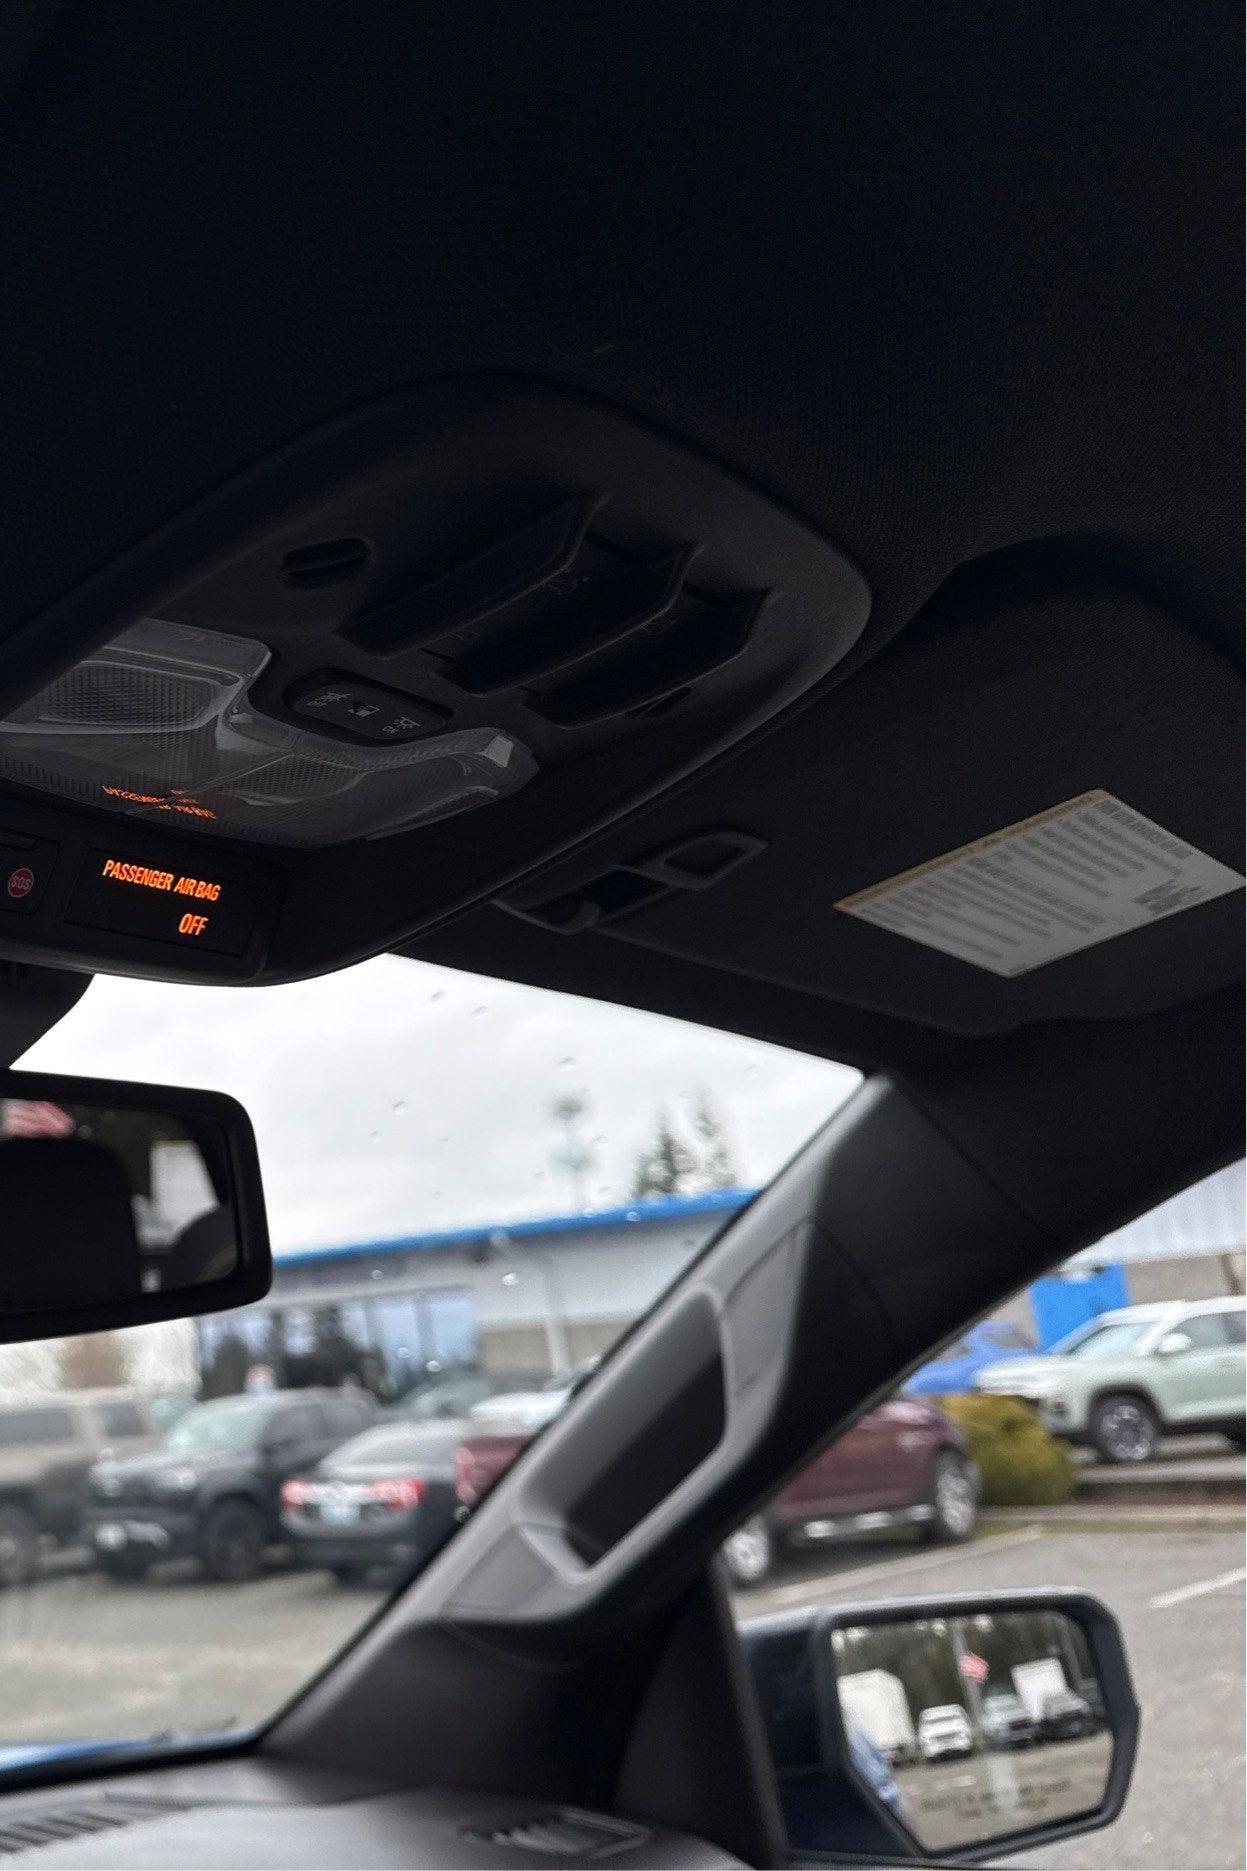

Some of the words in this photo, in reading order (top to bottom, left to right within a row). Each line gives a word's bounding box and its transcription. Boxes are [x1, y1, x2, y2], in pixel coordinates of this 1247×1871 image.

[10, 875, 32, 890] SOS
[102, 859, 175, 891] PASSENGER
[178, 913, 209, 936] OFF
